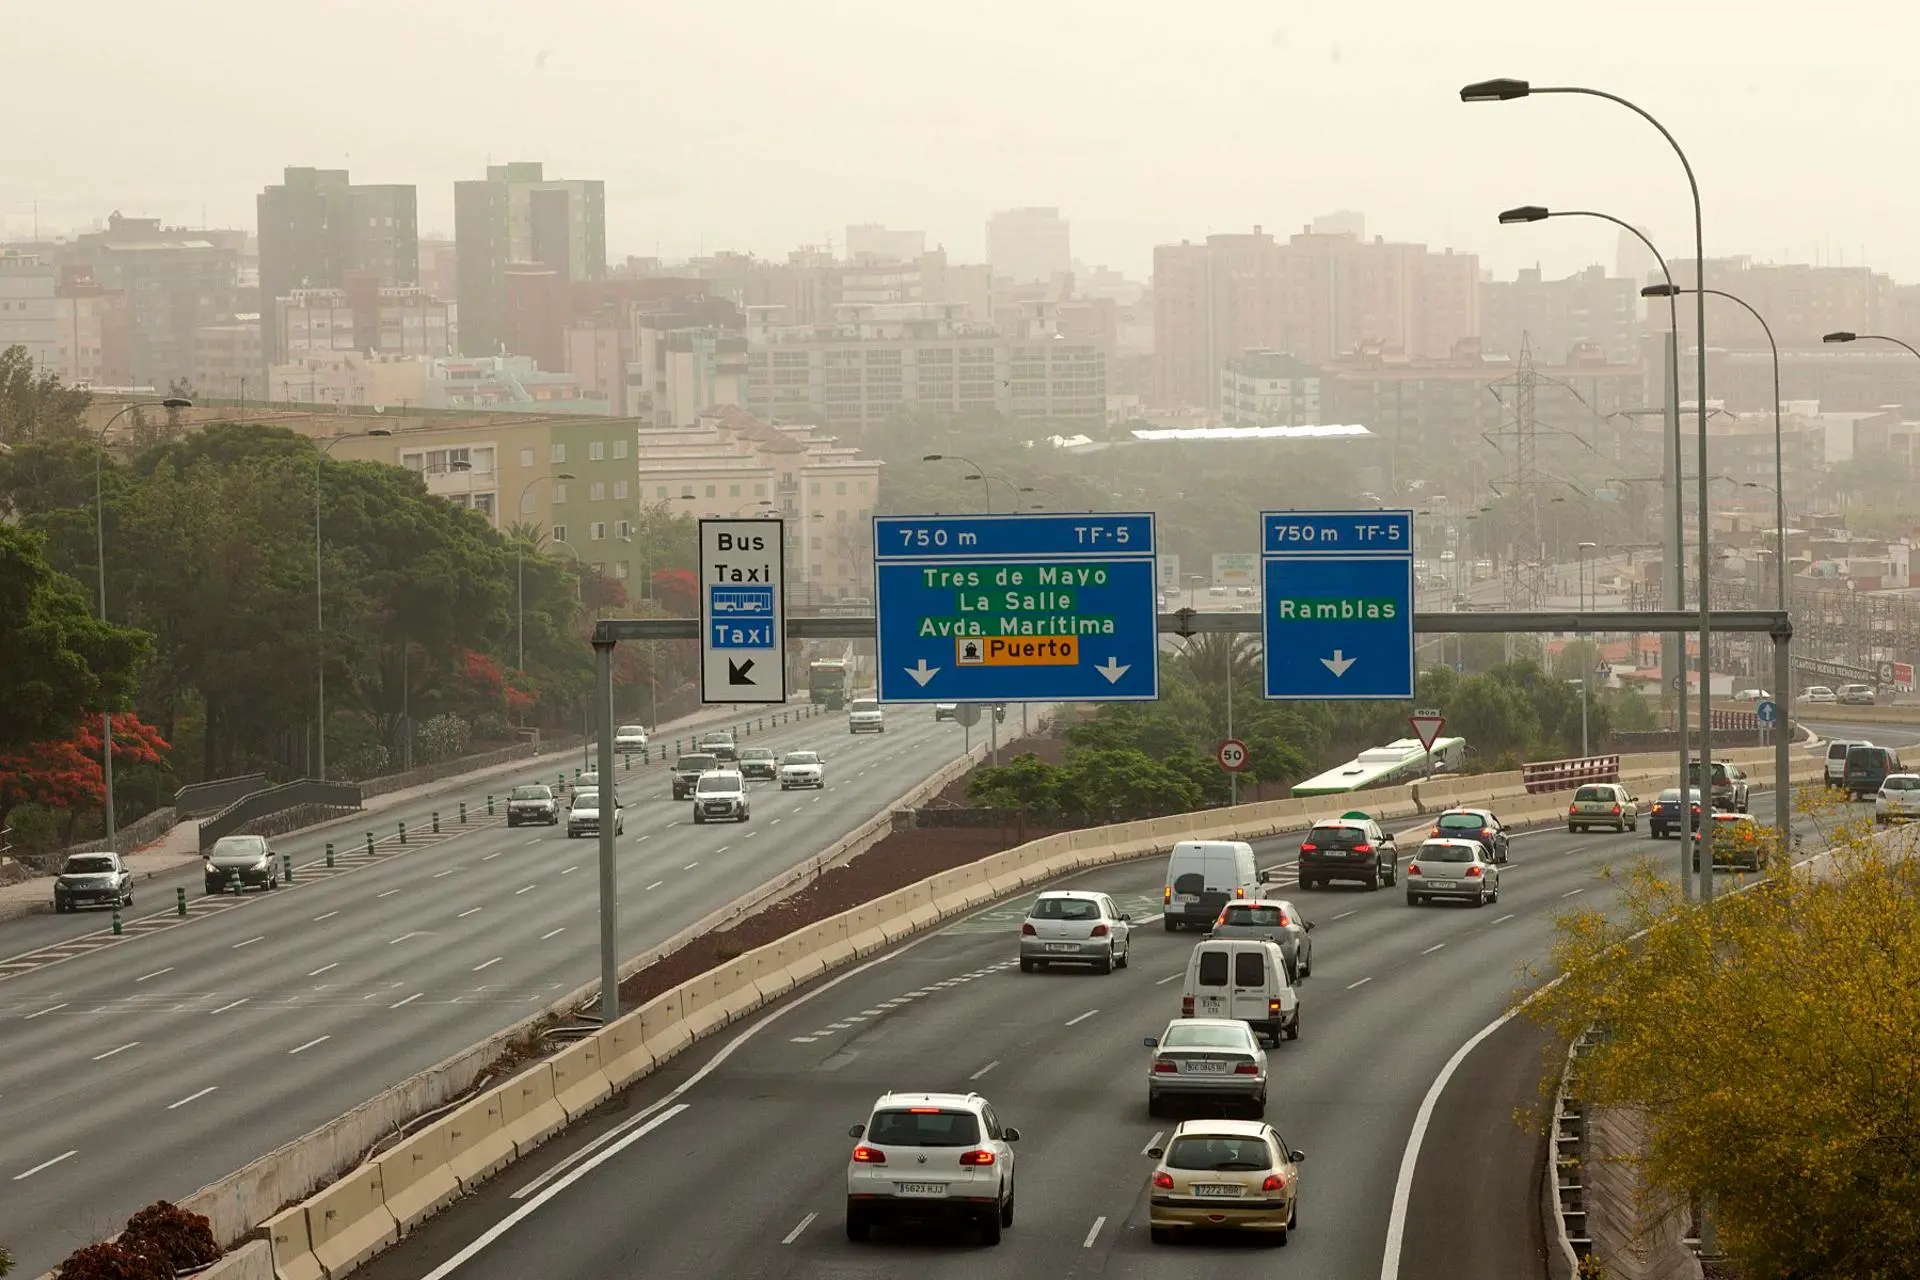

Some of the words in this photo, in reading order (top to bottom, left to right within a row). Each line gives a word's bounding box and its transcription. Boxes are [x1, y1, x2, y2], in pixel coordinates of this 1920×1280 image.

[717, 532, 765, 551] Bus
[899, 529, 948, 546] 750
[958, 532, 977, 545] m
[1074, 526, 1129, 544] TF-5
[1274, 525, 1315, 541] 750
[1320, 528, 1338, 541] m
[1354, 525, 1400, 541] TF-5
[714, 564, 769, 582] Taxi
[923, 569, 980, 587] Tres
[995, 567, 1023, 586] de
[1039, 567, 1106, 586] Mayo
[960, 592, 989, 611] La
[1005, 591, 1071, 610] Salle
[1280, 600, 1395, 619] Ramblas
[715, 624, 771, 644] Taxi
[919, 617, 987, 637] Avda.
[1000, 616, 1115, 636] Marítima
[990, 639, 1071, 658] Puerto
[1223, 750, 1242, 761] 50
